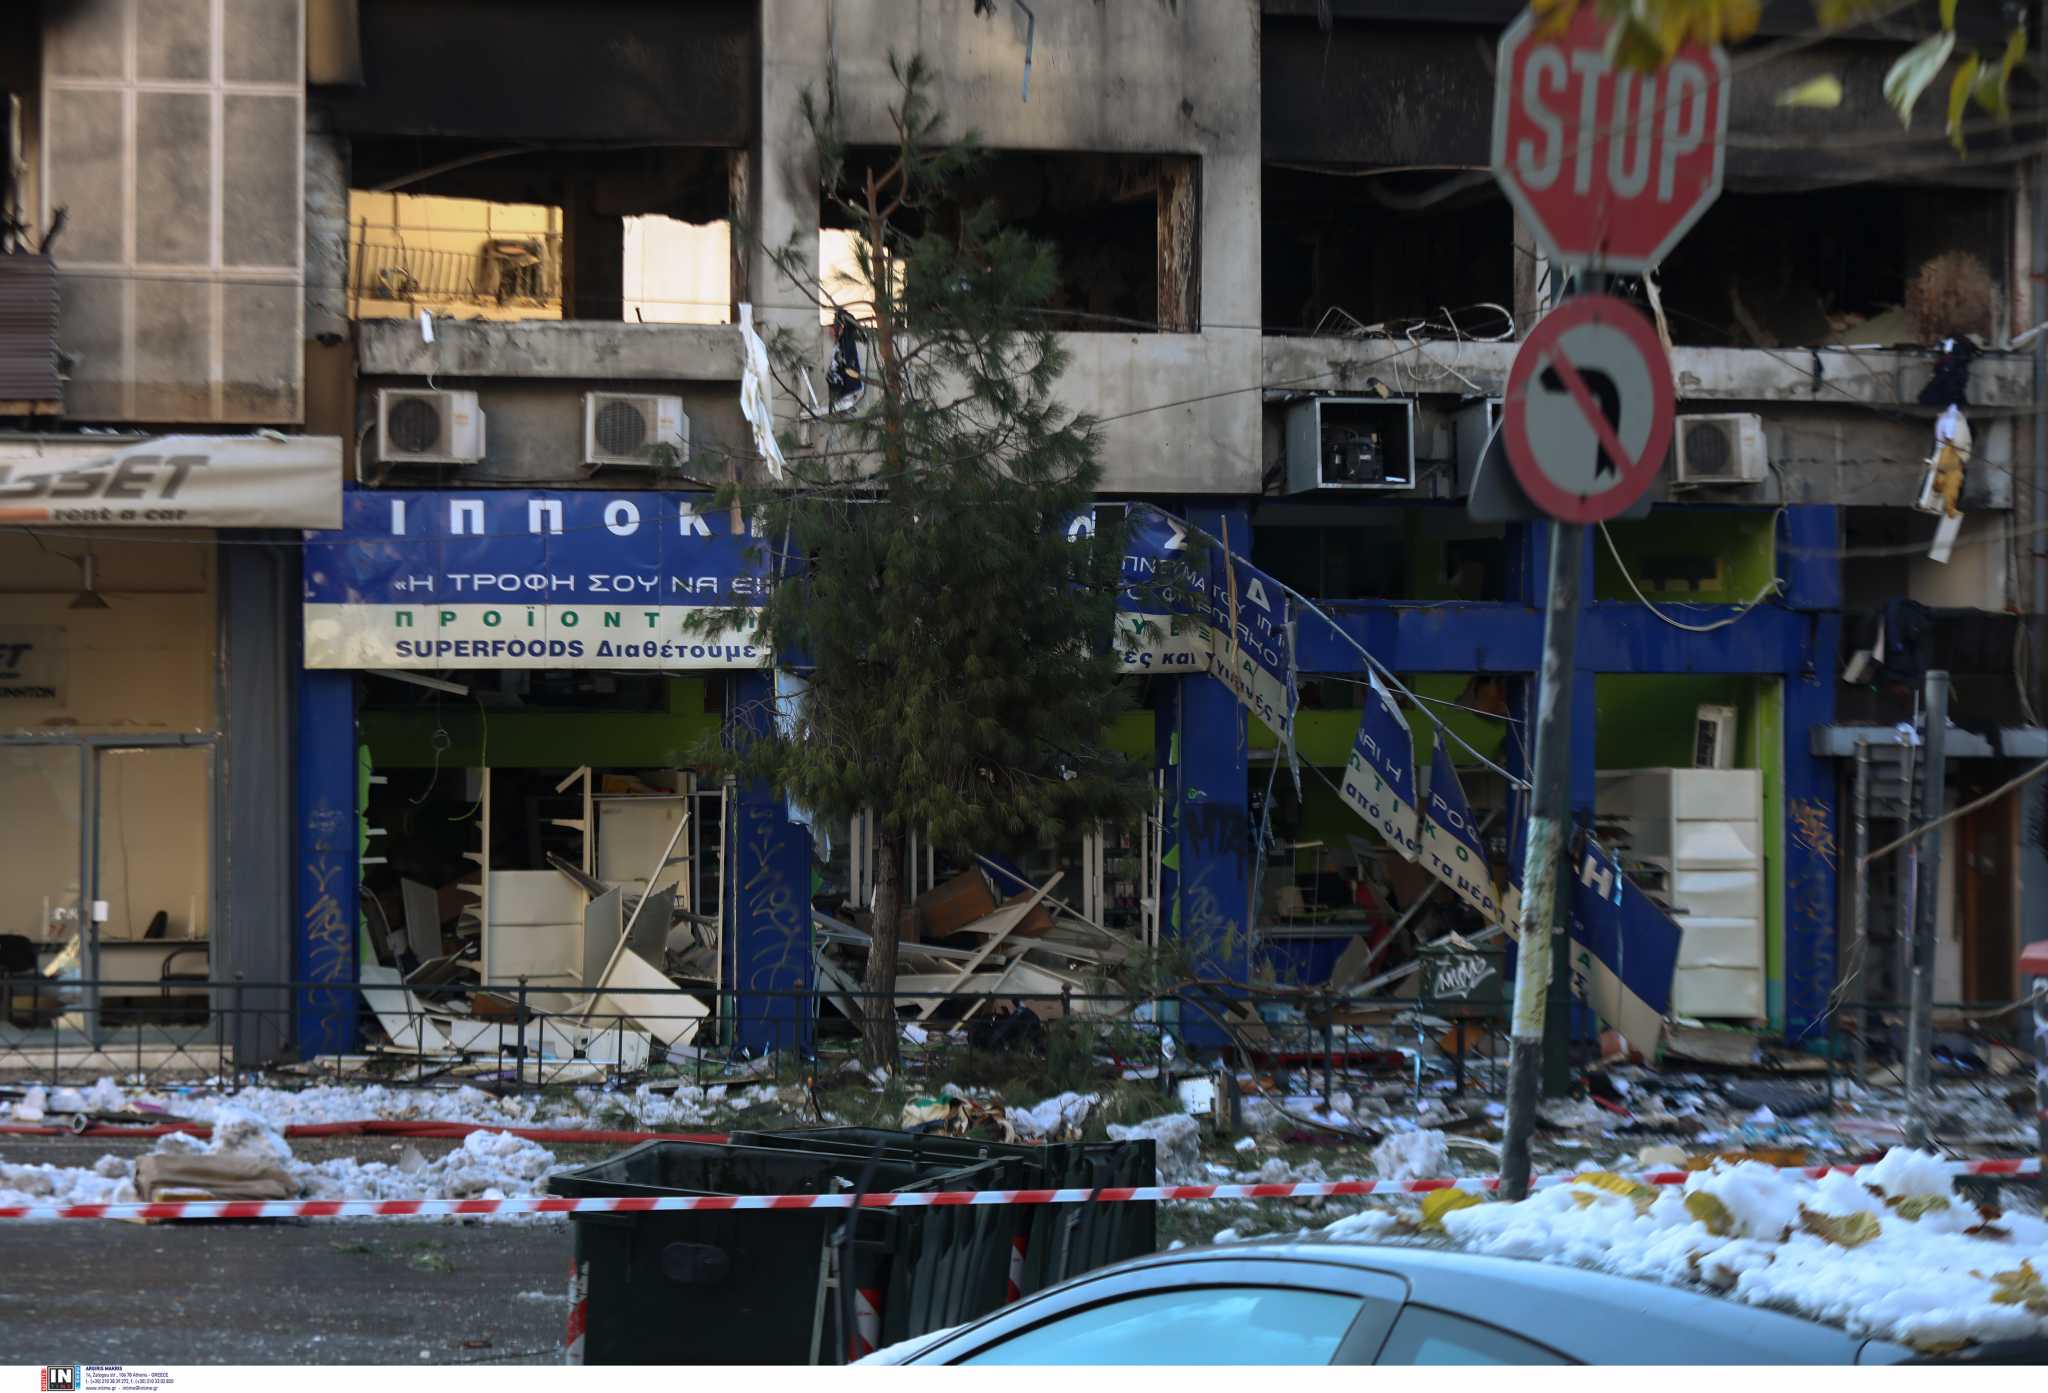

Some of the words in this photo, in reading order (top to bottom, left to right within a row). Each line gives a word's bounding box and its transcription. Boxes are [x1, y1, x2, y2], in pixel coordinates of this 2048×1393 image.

[1516, 46, 1708, 204] STOP
[0, 455, 210, 499] SSET
[54, 508, 112, 521] rent
[120, 510, 136, 521] a
[145, 509, 187, 521] car
[447, 573, 575, 594] ΤΡΟΦΗ
[588, 574, 660, 594] ΣΟΥ
[672, 575, 719, 595] ΝΑ
[396, 639, 584, 659] SUPERFOODS
[597, 638, 757, 664] Διαθέτουμε
[1162, 651, 1196, 666] και
[1346, 782, 1380, 819] από
[1431, 853, 1454, 877] τα
